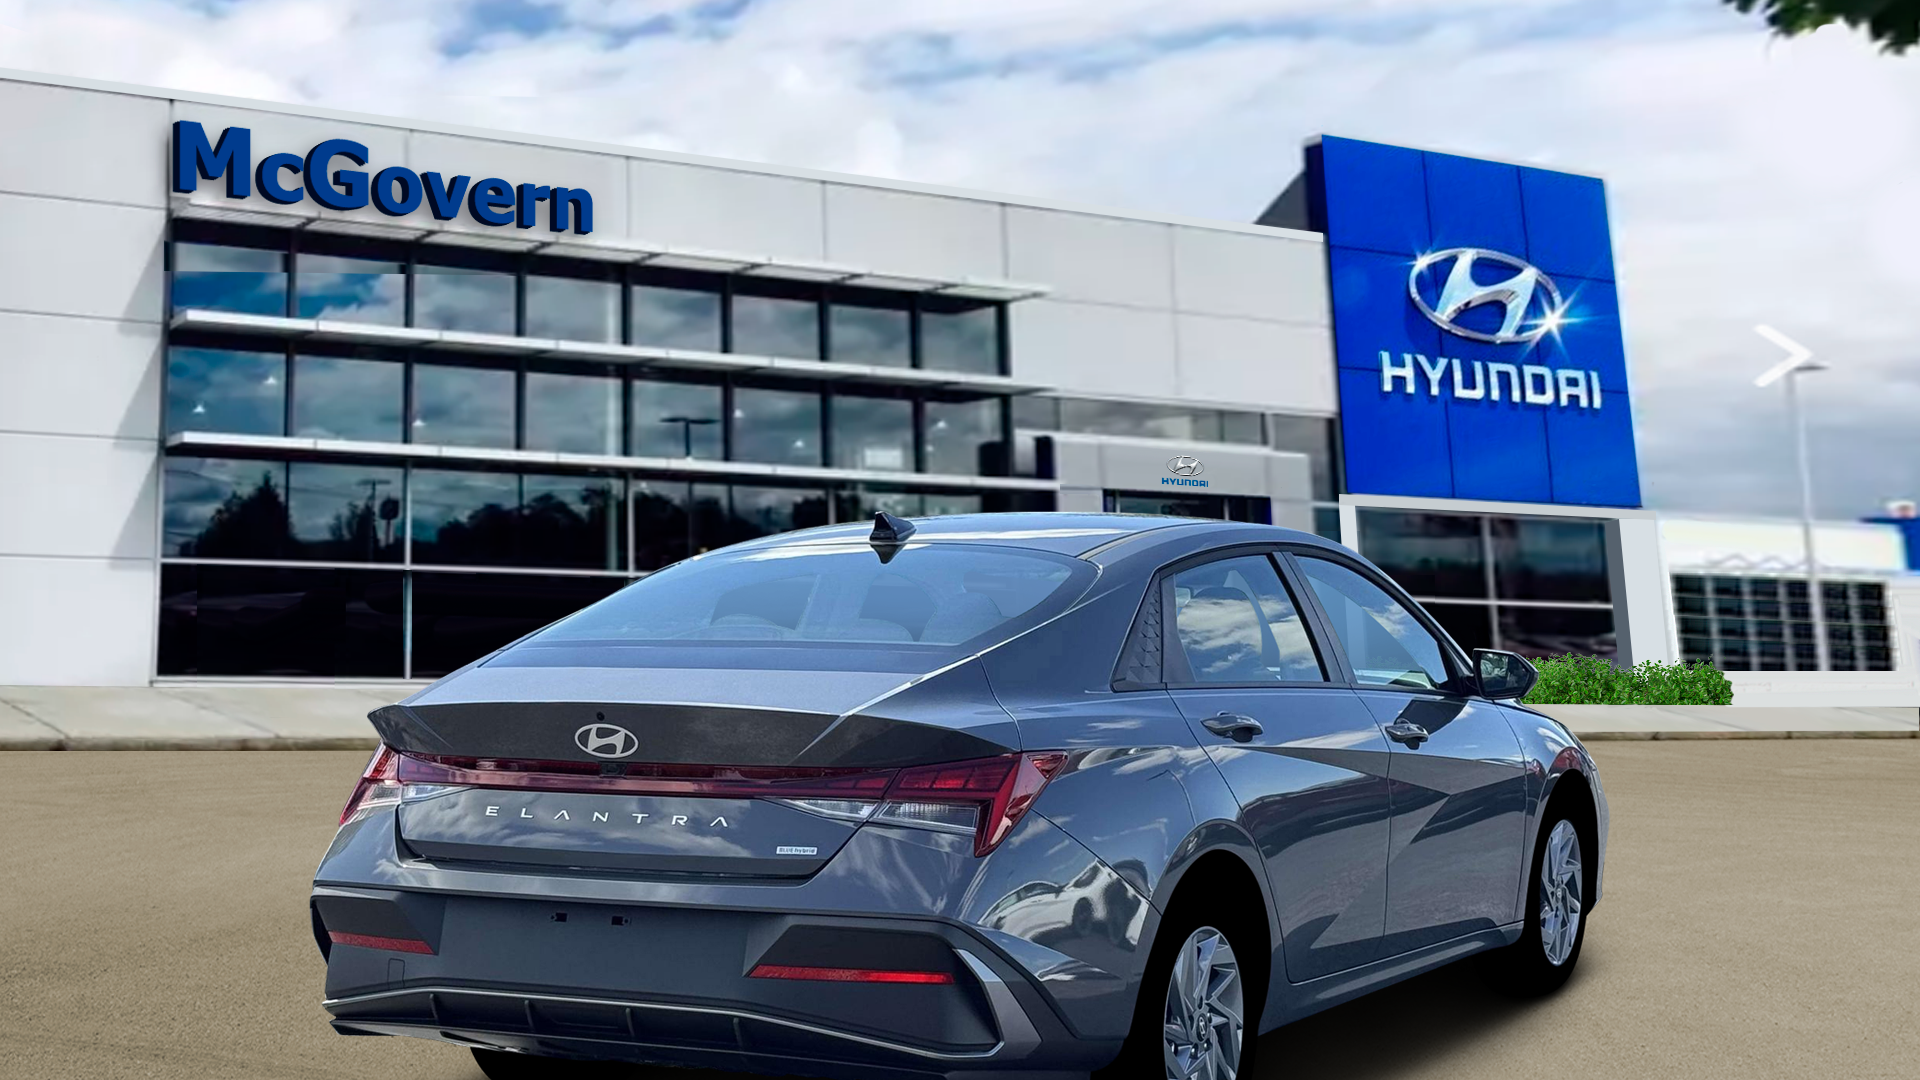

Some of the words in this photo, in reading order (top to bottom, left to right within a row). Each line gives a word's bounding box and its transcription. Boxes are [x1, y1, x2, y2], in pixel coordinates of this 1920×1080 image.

[172, 120, 594, 235] McGovern
[1378, 350, 1602, 409] HYUNDAI
[1161, 477, 1209, 488] HYUNDAI
[485, 805, 728, 828] ELANTRA
